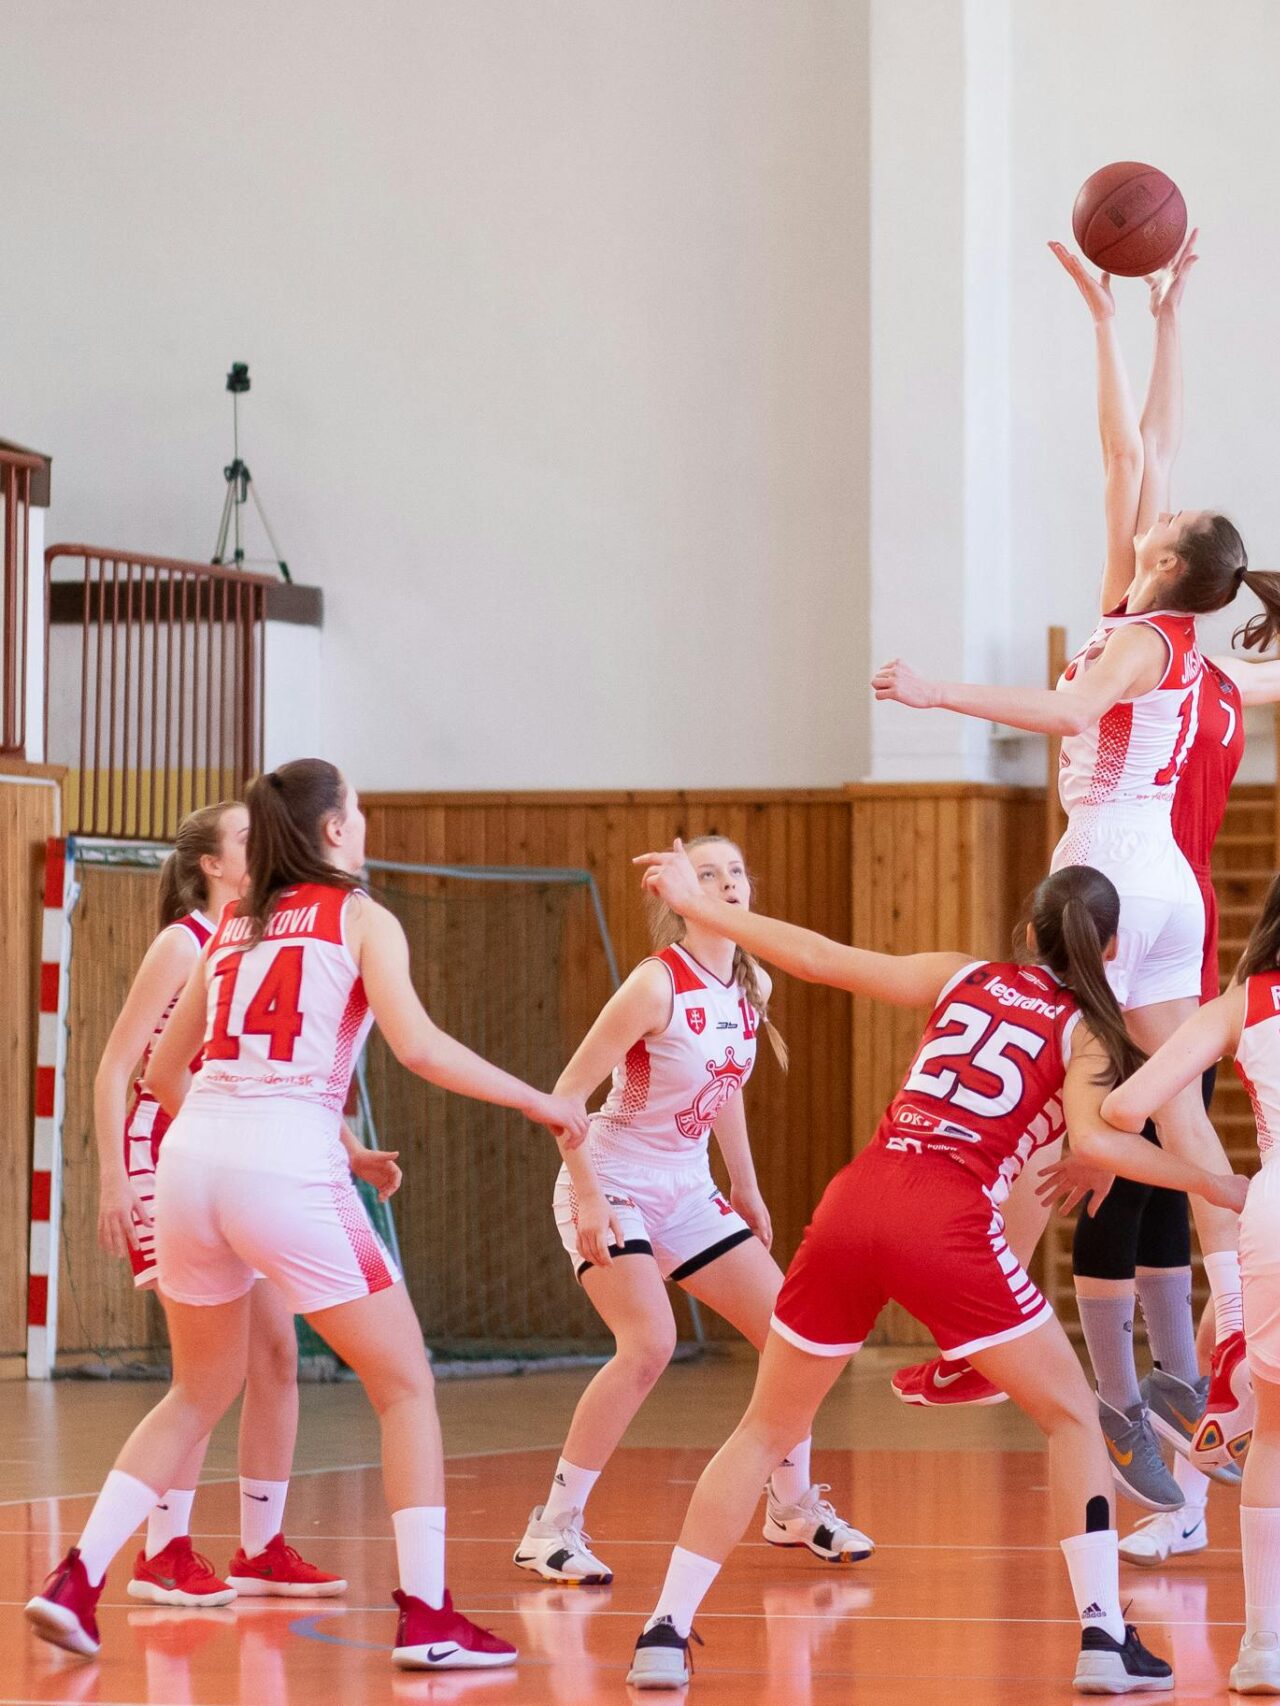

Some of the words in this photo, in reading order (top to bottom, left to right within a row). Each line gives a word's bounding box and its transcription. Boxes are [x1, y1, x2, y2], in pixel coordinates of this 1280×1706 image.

[201, 945, 305, 1062] 14
[983, 975, 1066, 1020] legrand
[903, 1001, 1048, 1118] 25
